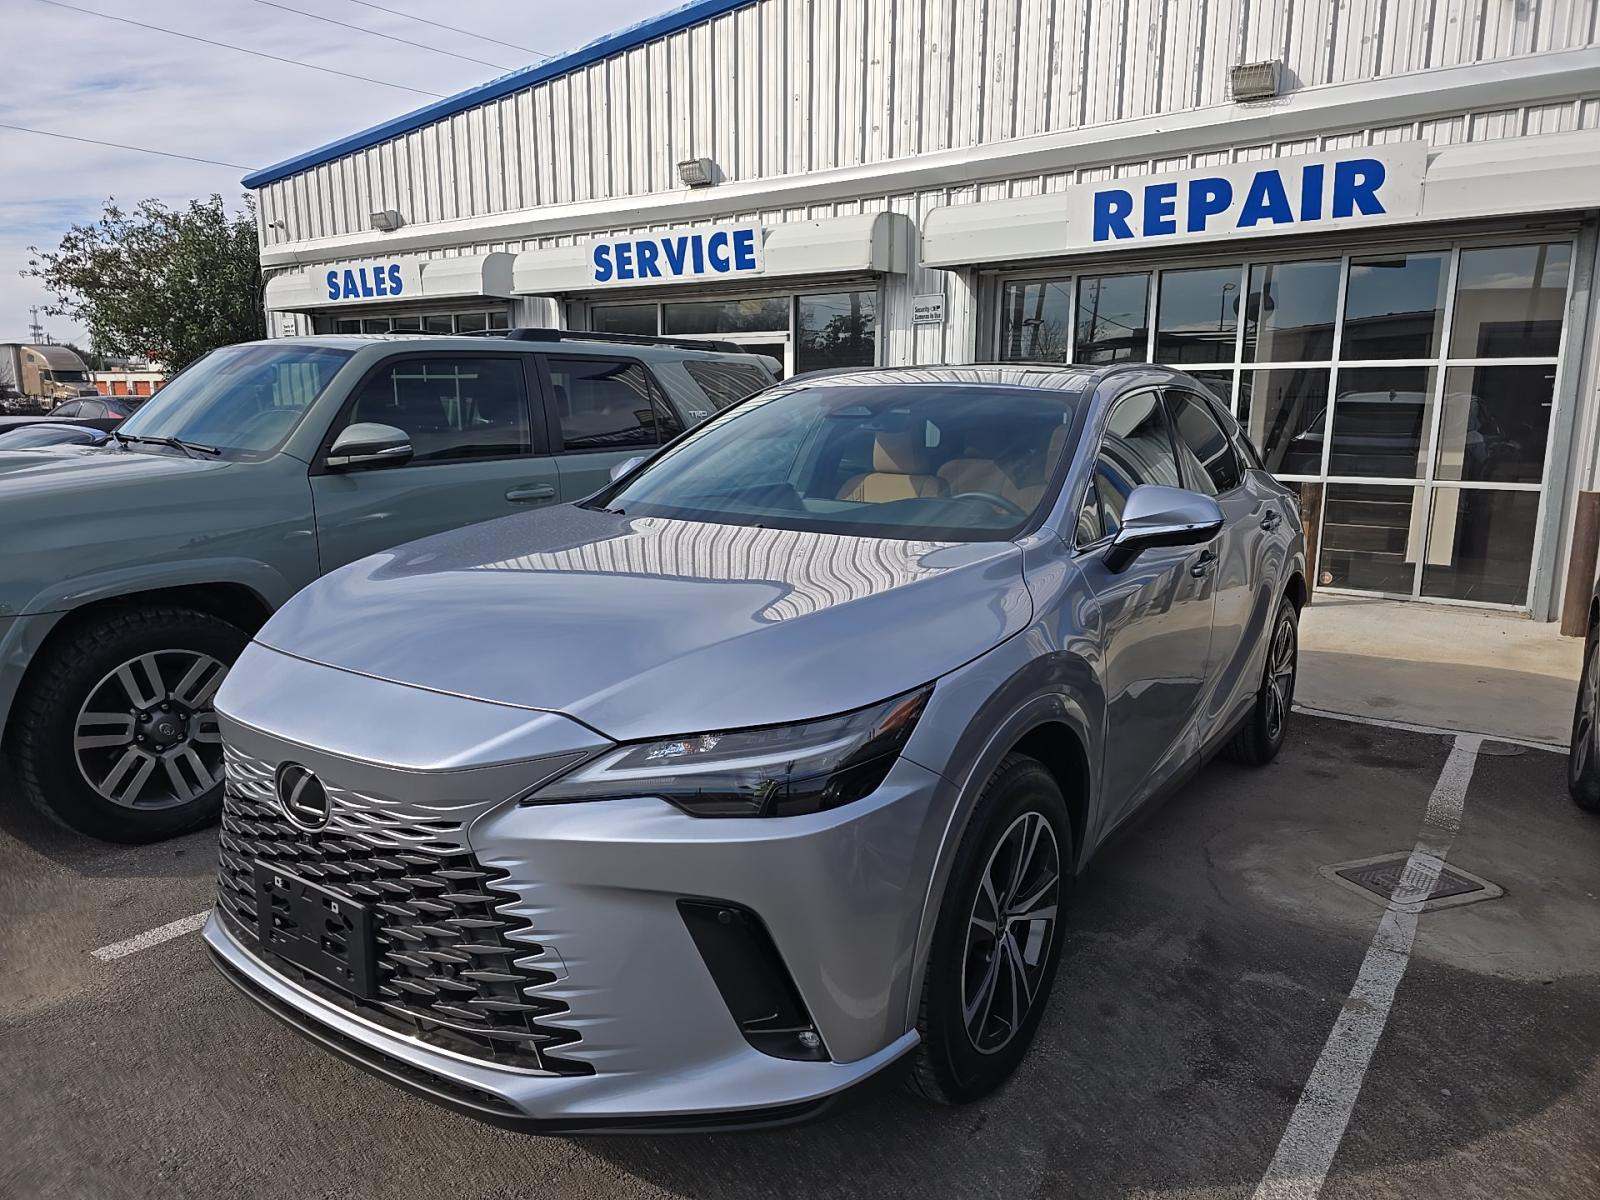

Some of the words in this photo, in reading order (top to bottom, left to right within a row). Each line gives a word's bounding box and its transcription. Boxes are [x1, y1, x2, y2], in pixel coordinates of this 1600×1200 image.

[1093, 158, 1386, 241] REPAIR
[593, 229, 757, 283] SERVICE
[326, 264, 403, 300] SALES
[688, 410, 708, 418] TRD
